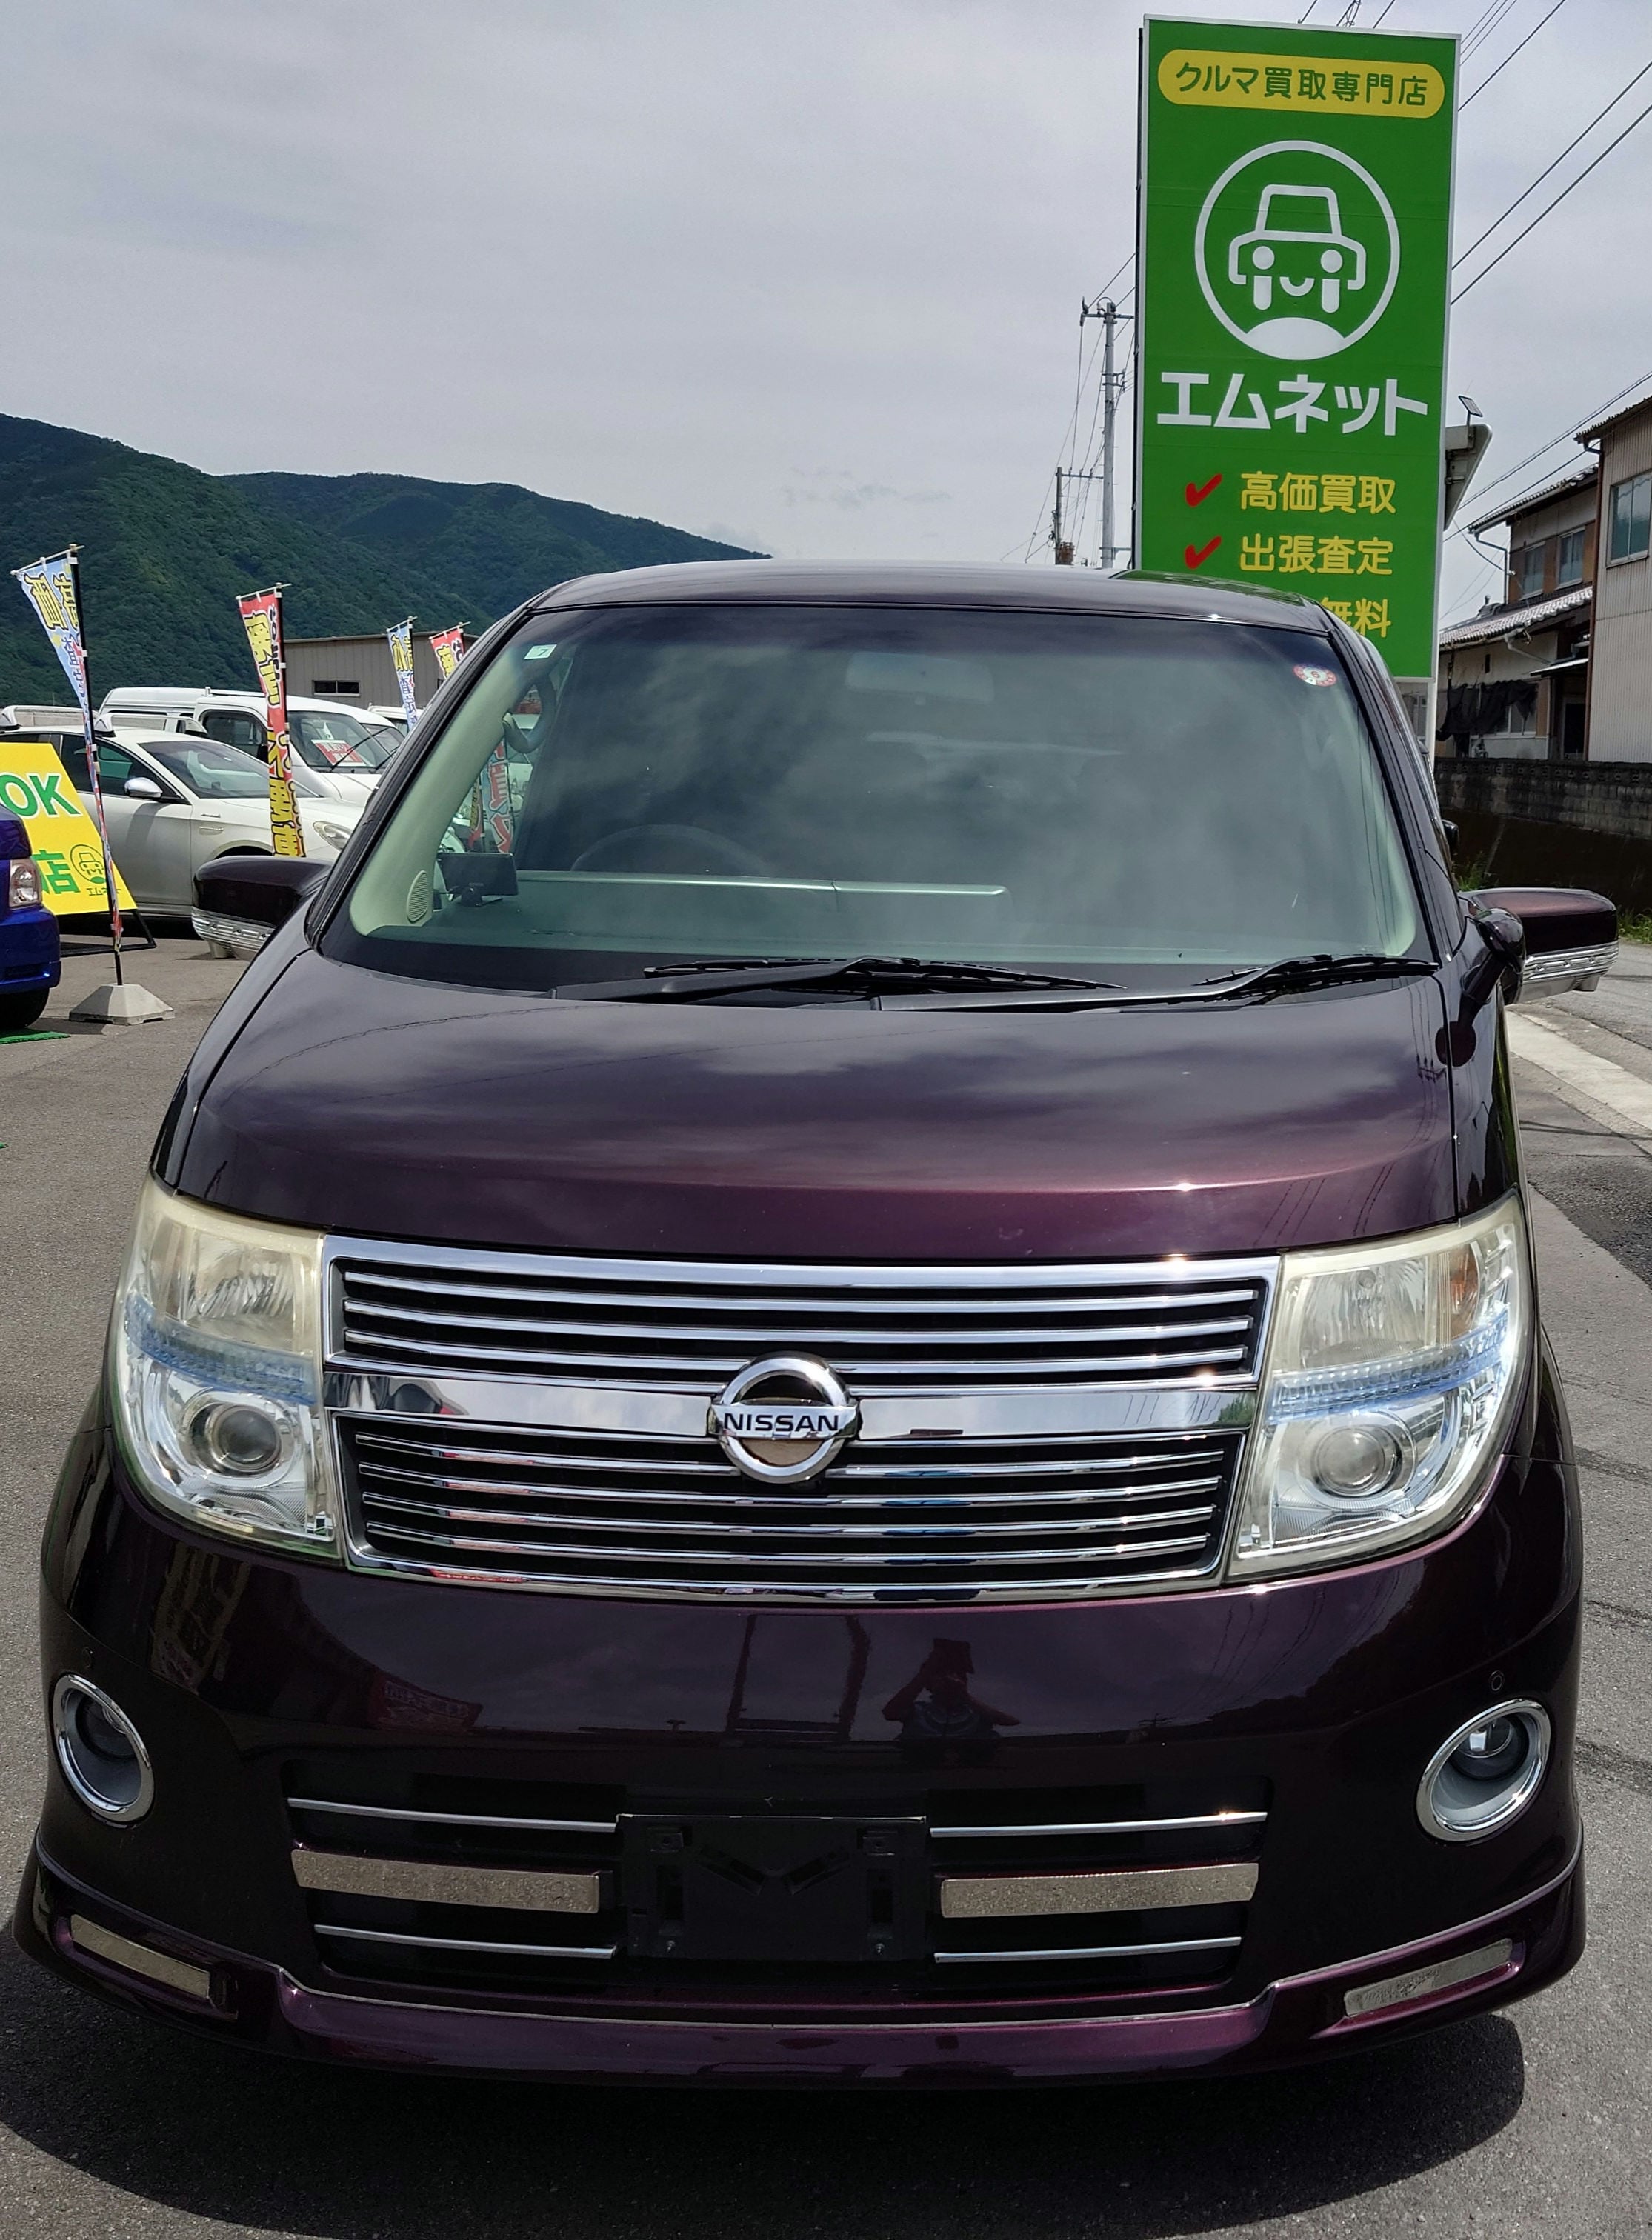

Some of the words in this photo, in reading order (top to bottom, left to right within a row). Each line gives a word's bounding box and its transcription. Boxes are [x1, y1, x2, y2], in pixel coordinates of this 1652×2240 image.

[1176, 62, 1428, 106] クルマ買取専門店
[1156, 372, 1428, 436] エムネット
[1240, 471, 1396, 514] 高価買取
[1239, 533, 1393, 576] 出張査定
[0, 774, 81, 817] OK
[723, 1413, 839, 1432] NISSAN
